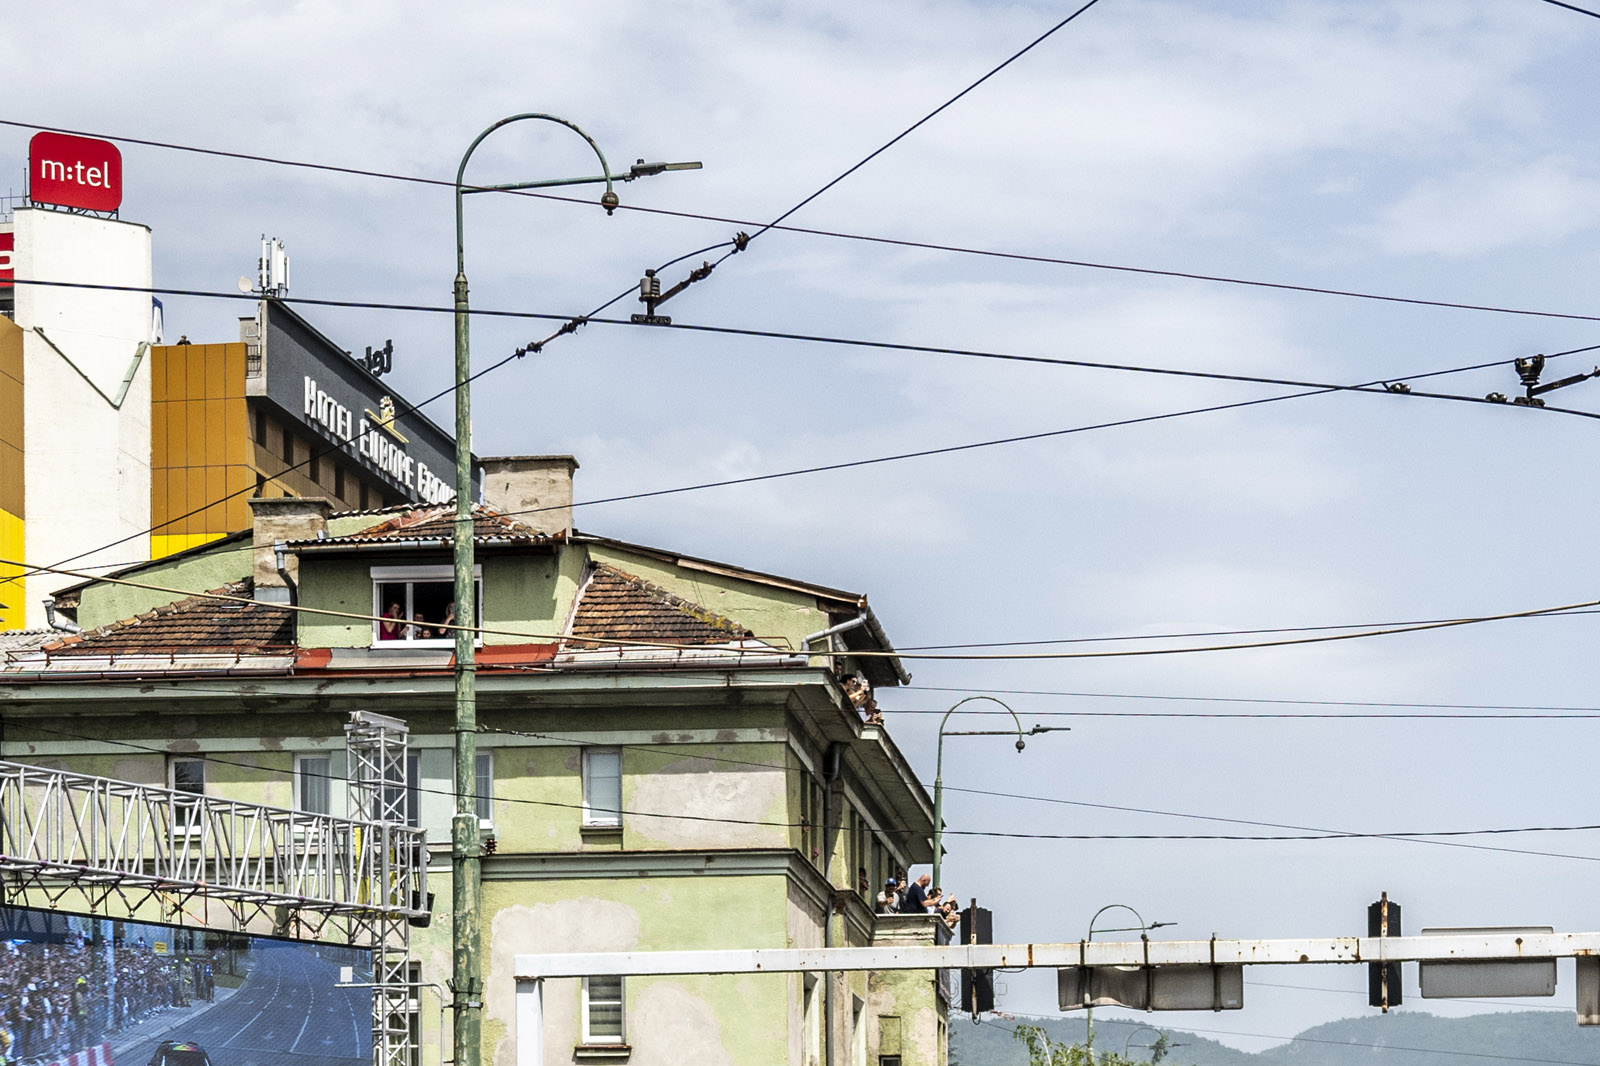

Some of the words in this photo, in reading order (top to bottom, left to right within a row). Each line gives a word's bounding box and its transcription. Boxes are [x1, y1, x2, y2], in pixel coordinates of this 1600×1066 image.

[41, 159, 111, 189] m:tel
[304, 376, 356, 447] HOTEL
[360, 419, 414, 490] EUROPE
